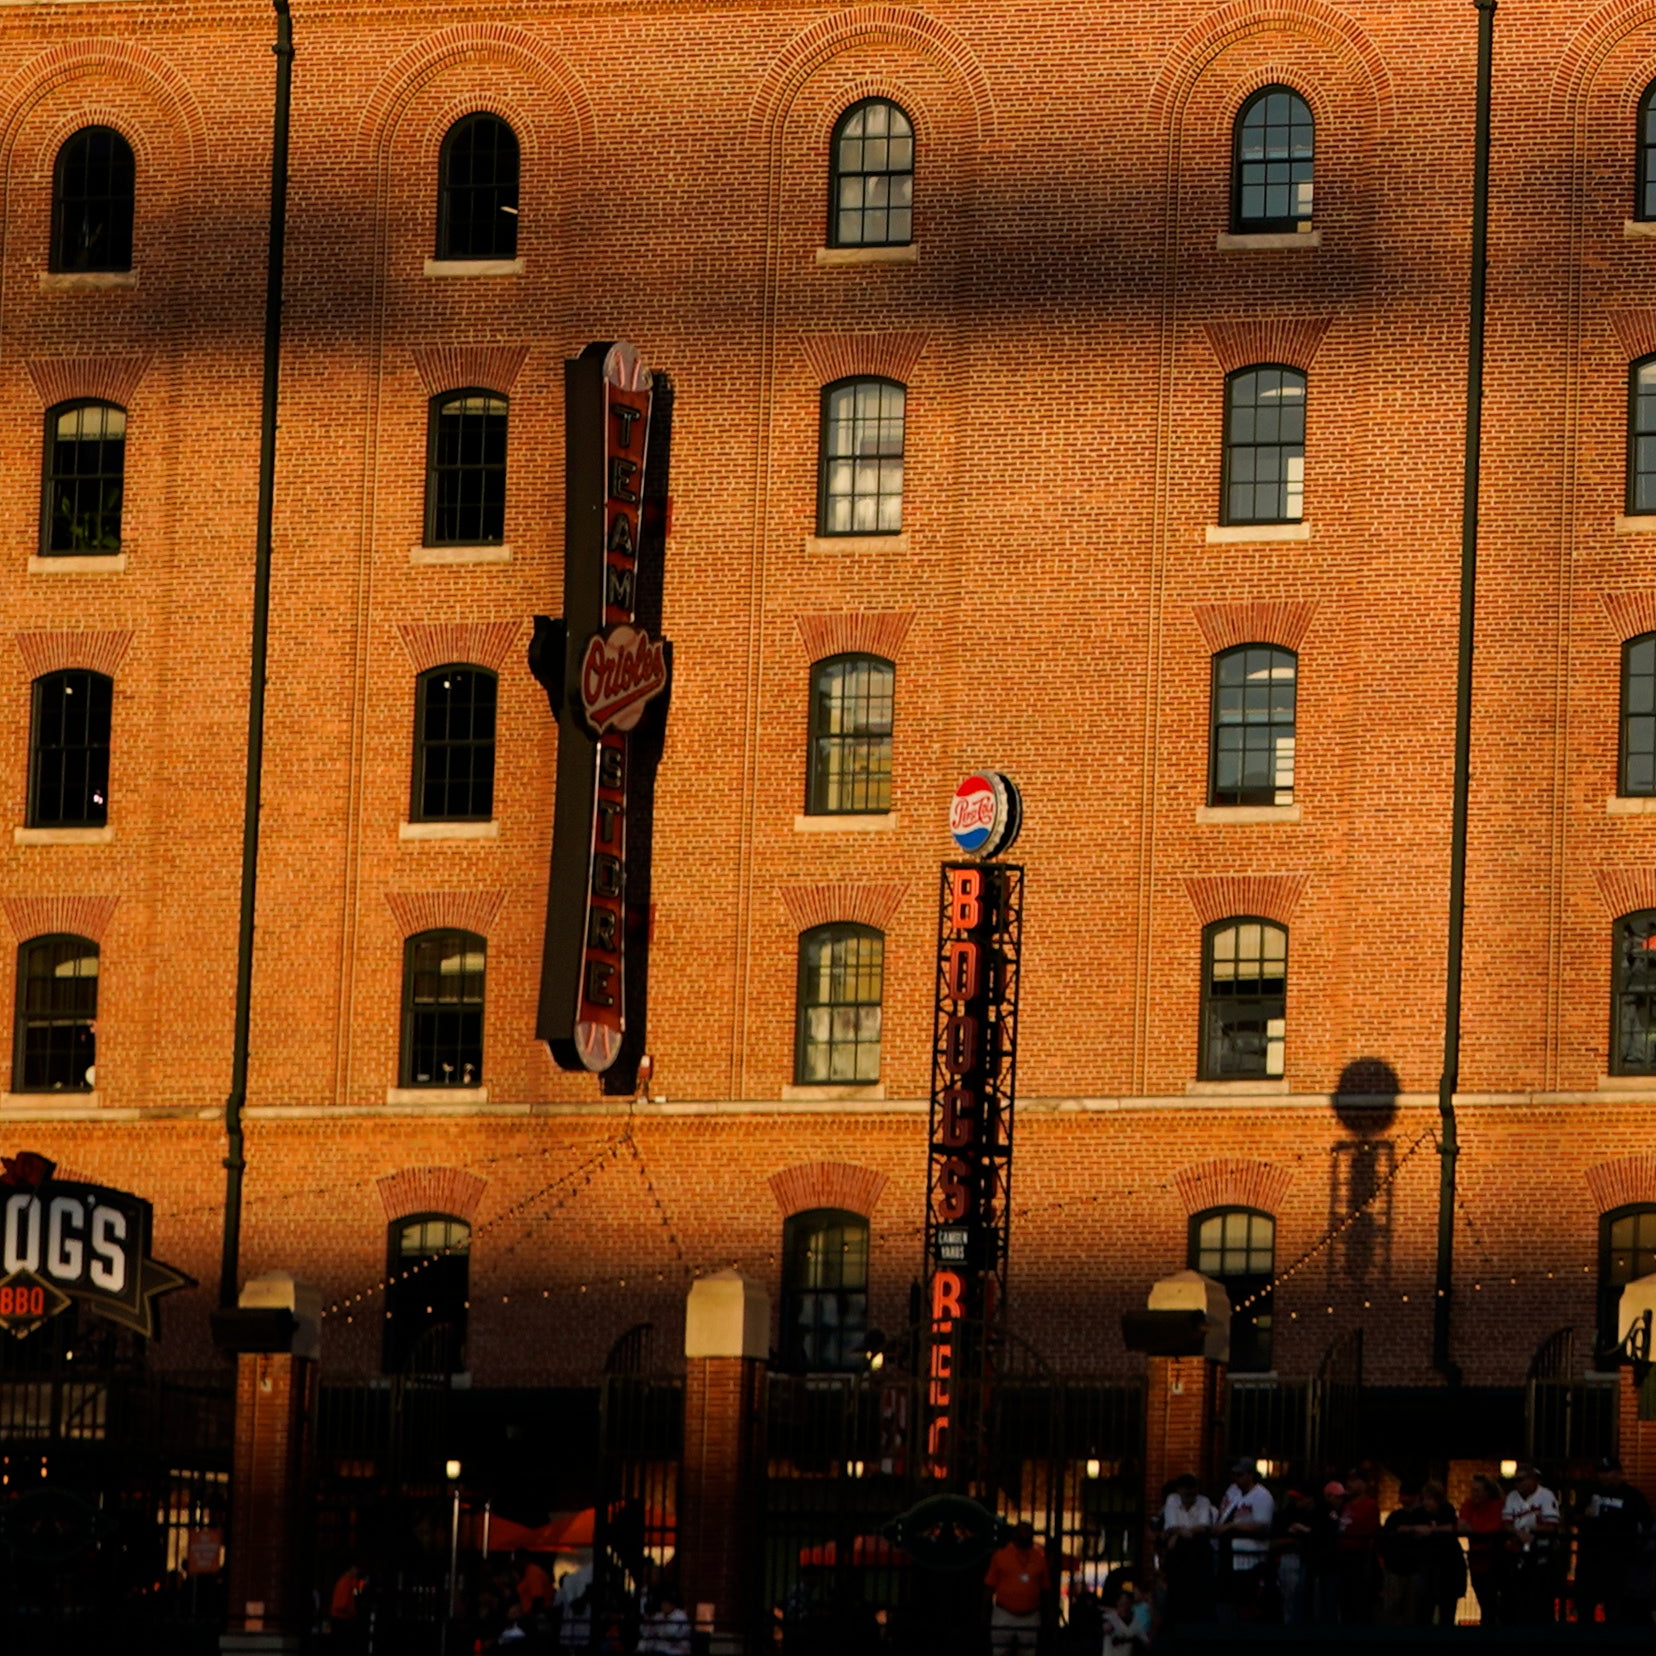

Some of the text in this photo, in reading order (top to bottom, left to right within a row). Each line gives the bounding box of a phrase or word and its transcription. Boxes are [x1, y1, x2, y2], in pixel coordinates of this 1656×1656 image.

[607, 403, 641, 611] TEAM
[584, 633, 664, 705] Orioles
[586, 747, 622, 1007] STORE
[0, 1286, 44, 1316] BBQ
